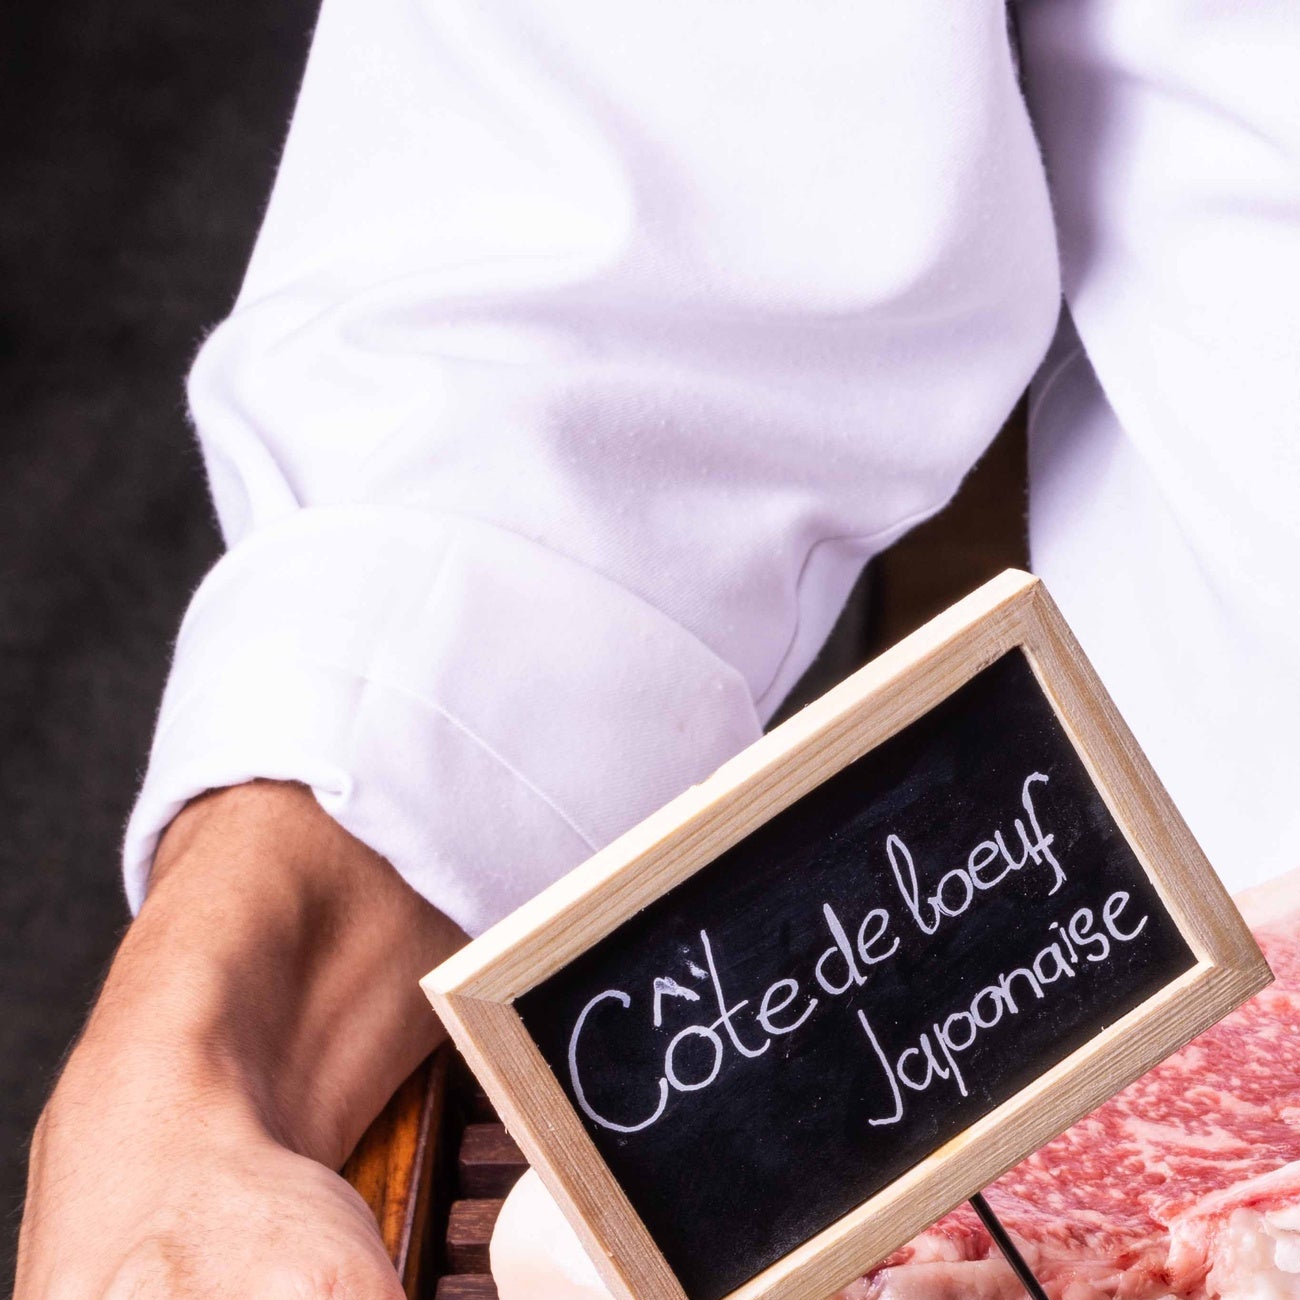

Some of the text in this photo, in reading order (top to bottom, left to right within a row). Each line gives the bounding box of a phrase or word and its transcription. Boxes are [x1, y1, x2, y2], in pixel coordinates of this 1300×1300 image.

[569, 773, 1065, 1131] Côte de boeuf
[859, 892, 1147, 1125] Japonaise
